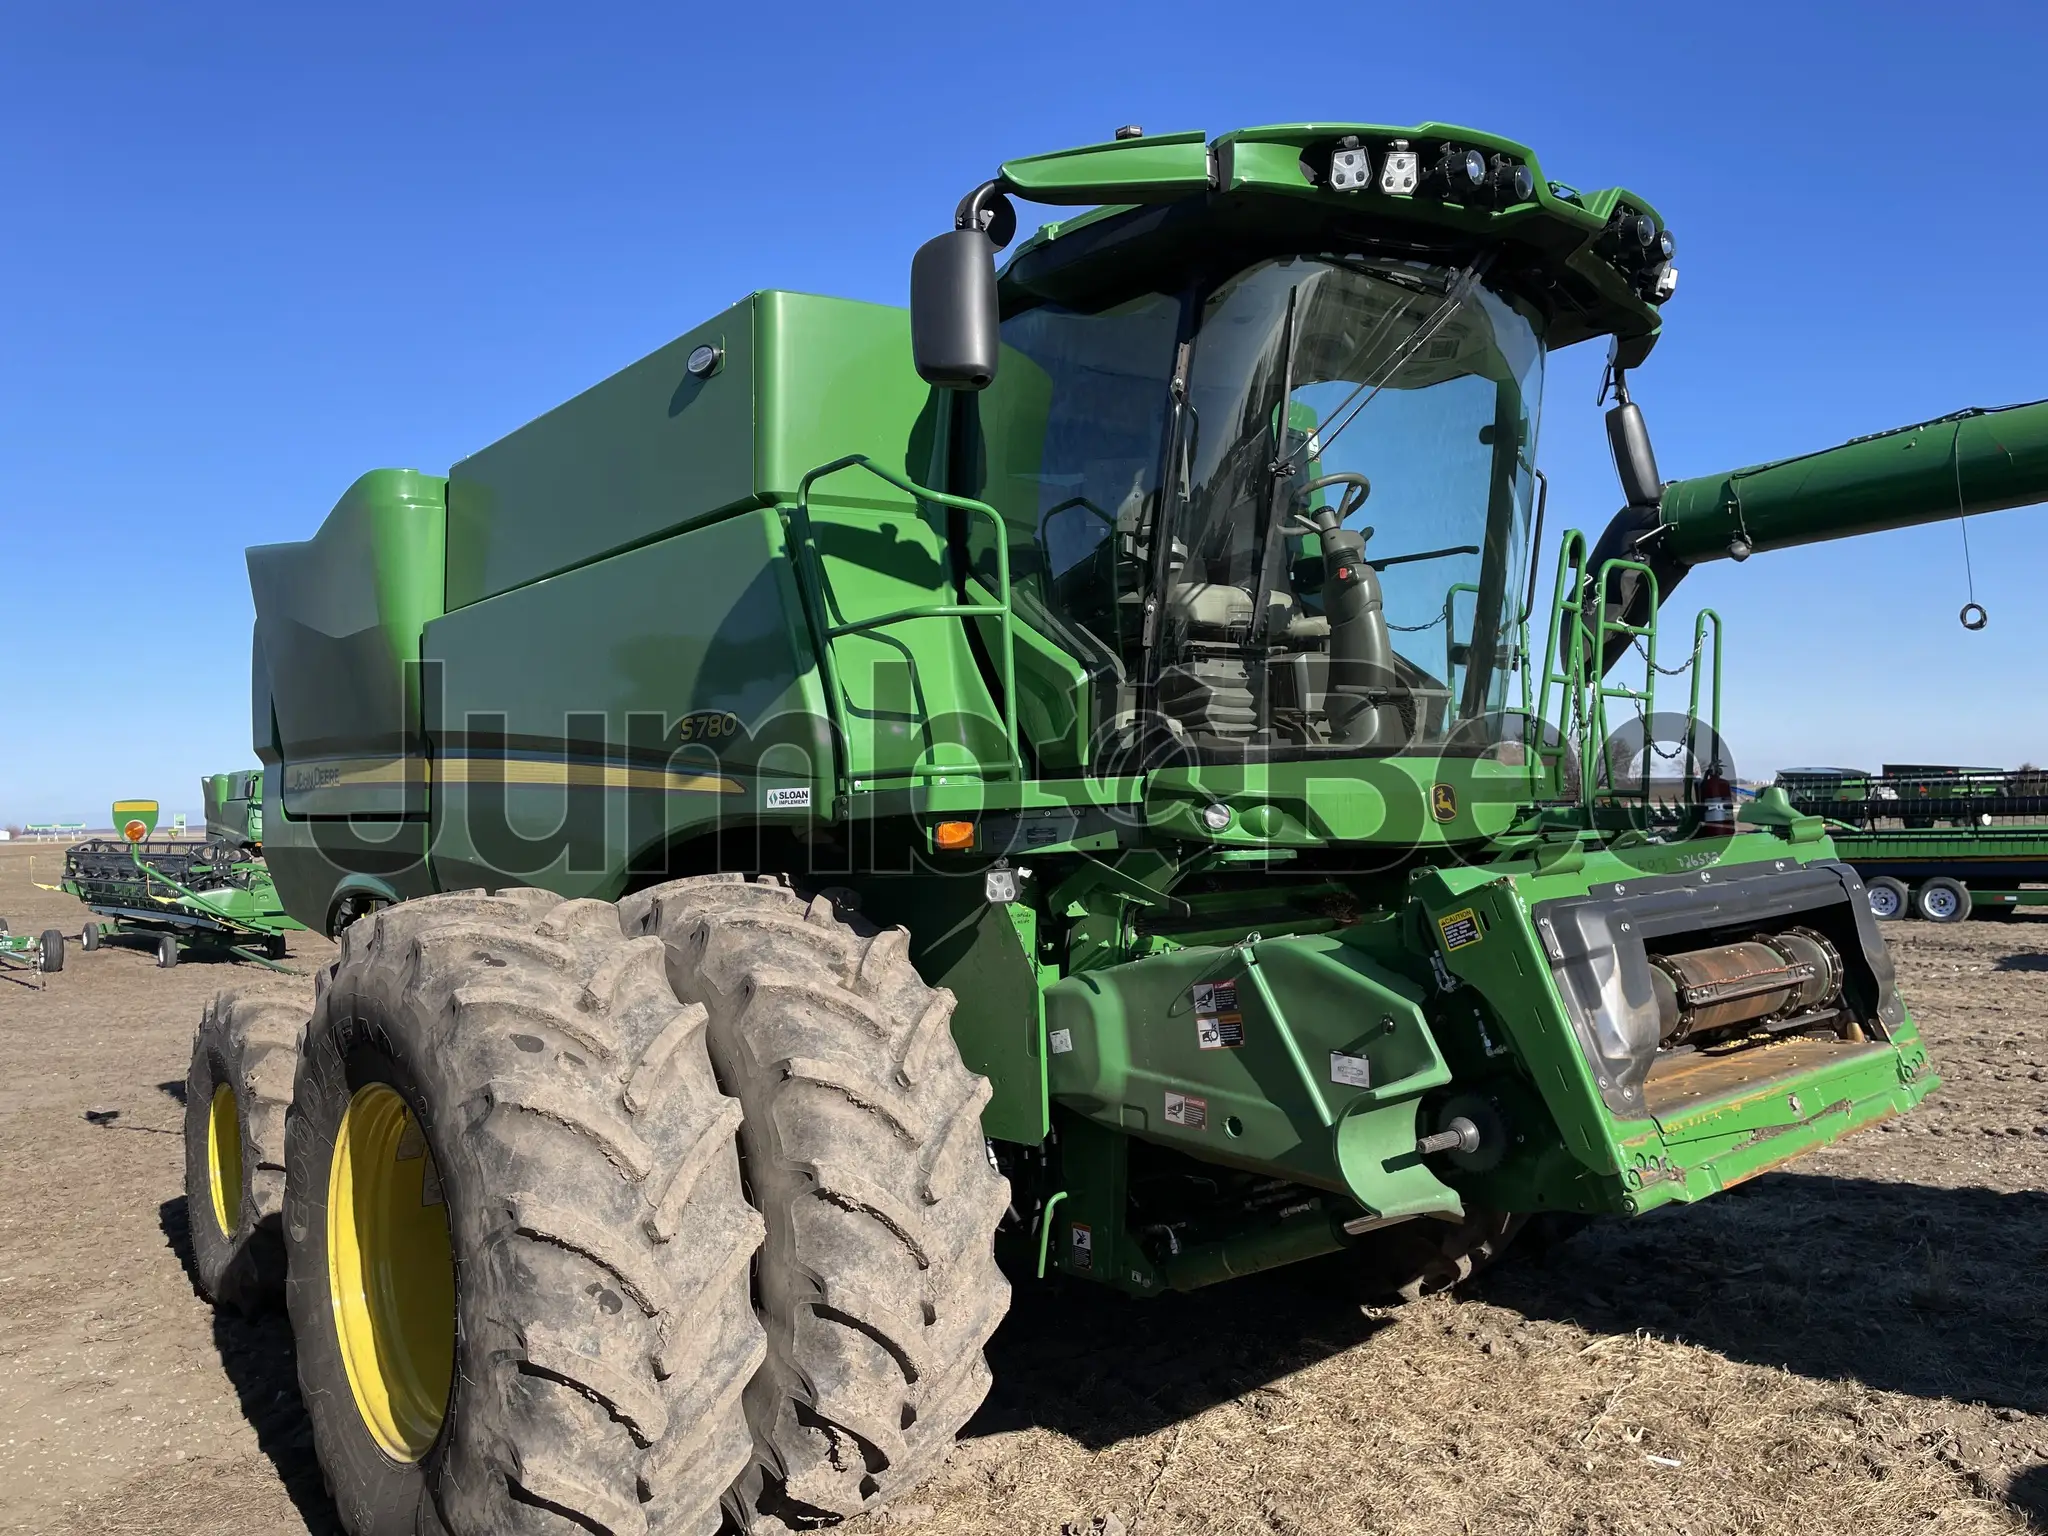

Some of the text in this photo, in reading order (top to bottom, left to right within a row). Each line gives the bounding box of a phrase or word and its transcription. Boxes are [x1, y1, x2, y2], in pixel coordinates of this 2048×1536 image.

[680, 711, 738, 741] S780
[314, 767, 340, 787] DEERE
[778, 790, 809, 800] SLOAN
[1446, 910, 1471, 925] CAUTION
